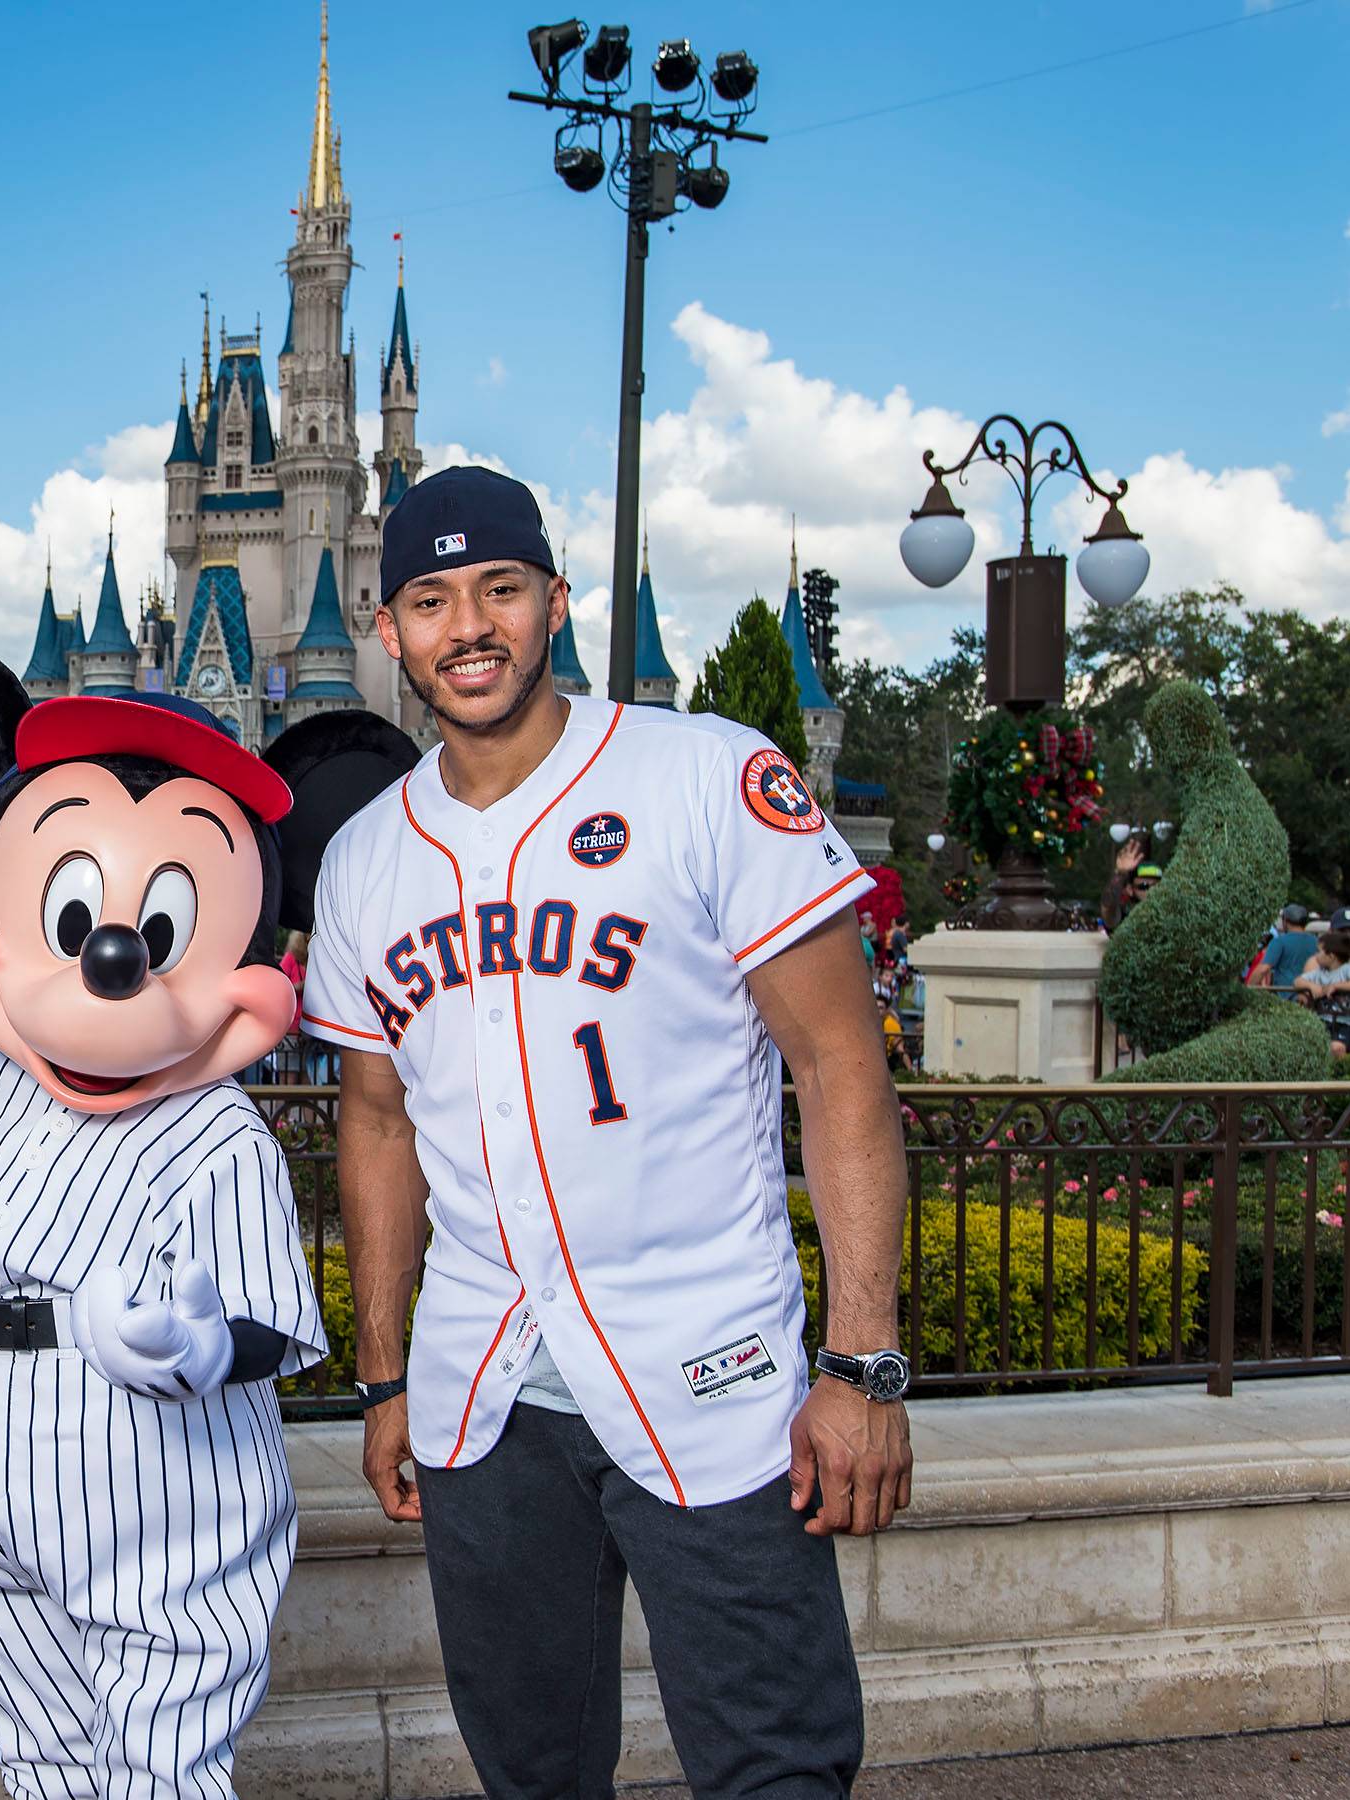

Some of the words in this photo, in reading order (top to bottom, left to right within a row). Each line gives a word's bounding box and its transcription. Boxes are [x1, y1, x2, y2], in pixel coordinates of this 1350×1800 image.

[747, 753, 790, 792] HOUSTON
[573, 831, 625, 850] STRONG
[365, 899, 648, 1049] ASTROS
[573, 1020, 628, 1126] 1
